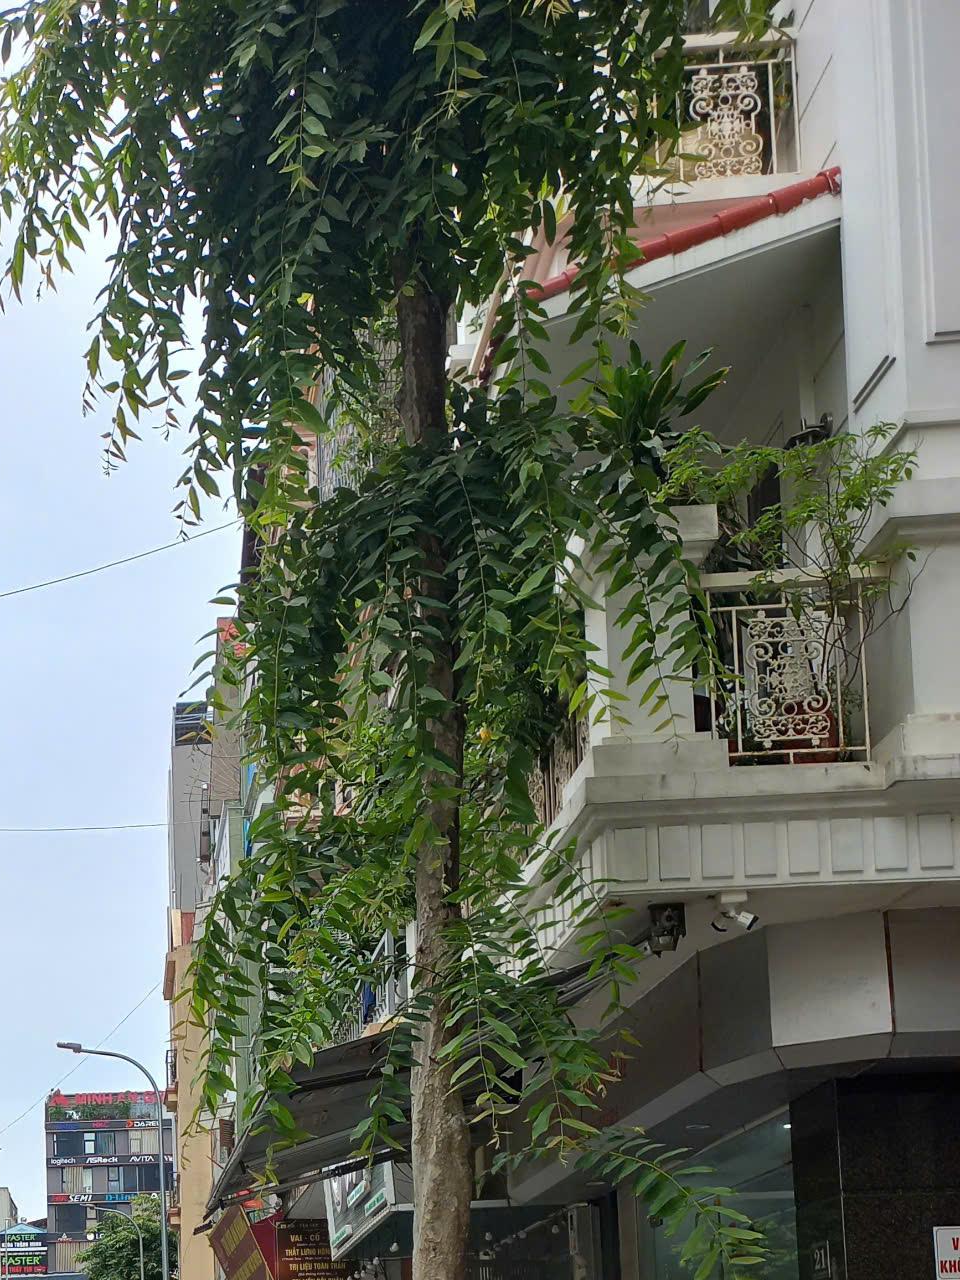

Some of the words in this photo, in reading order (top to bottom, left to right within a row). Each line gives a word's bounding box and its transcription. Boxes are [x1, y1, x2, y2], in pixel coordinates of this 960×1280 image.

[50, 1157, 76, 1166] logitech
[7, 1234, 36, 1242] FASTER
[290, 1234, 302, 1242] VAI
[951, 1237, 960, 1251] V
[2, 1256, 40, 1266] FASTER
[814, 1248, 826, 1271] 21
